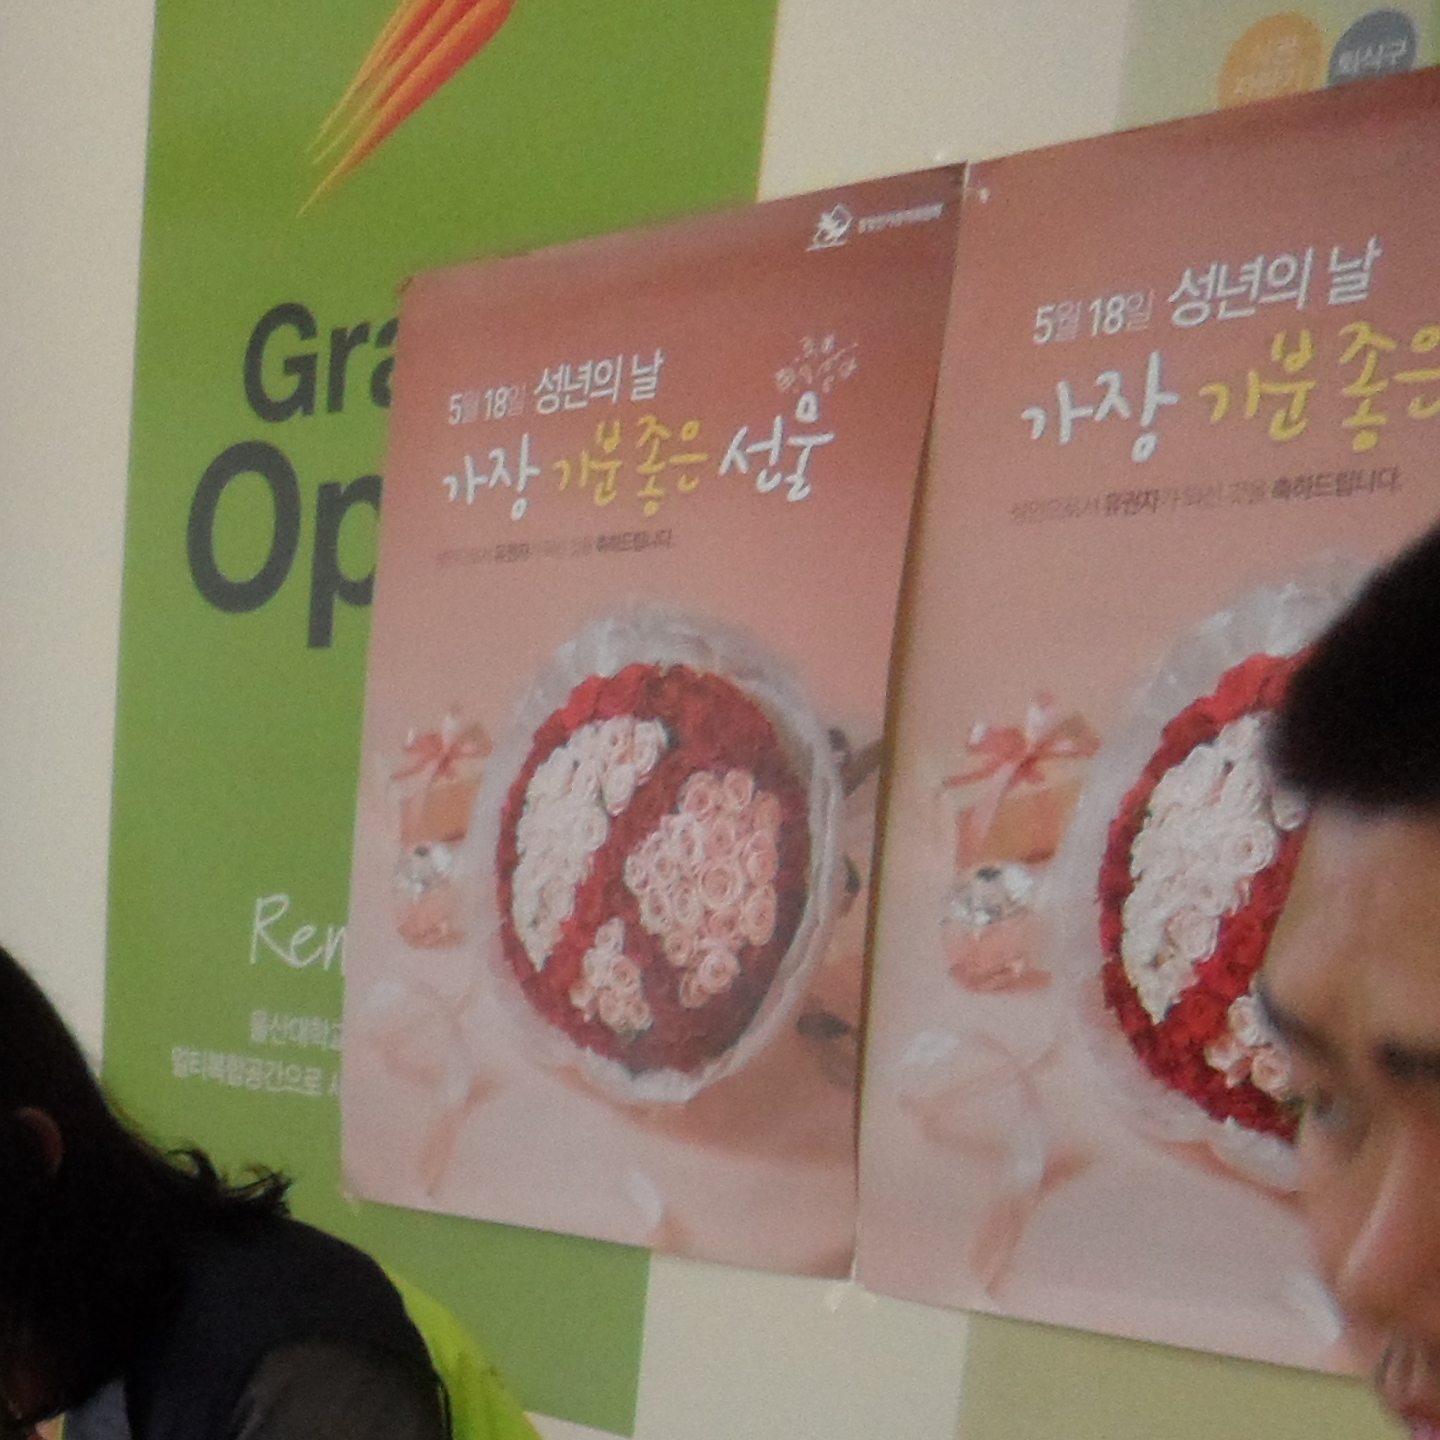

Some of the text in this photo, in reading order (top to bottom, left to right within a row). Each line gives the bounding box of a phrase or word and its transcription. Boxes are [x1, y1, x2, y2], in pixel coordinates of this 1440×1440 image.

[1089, 289, 1154, 337] 18일
[1168, 246, 1316, 328] 성년의
[1328, 236, 1383, 306] 날
[534, 354, 623, 415] 성년의
[630, 347, 665, 401] 날
[1021, 350, 1181, 463] 가장
[442, 433, 542, 521] 가장
[720, 390, 837, 502] 선물
[185, 439, 383, 650] Op
